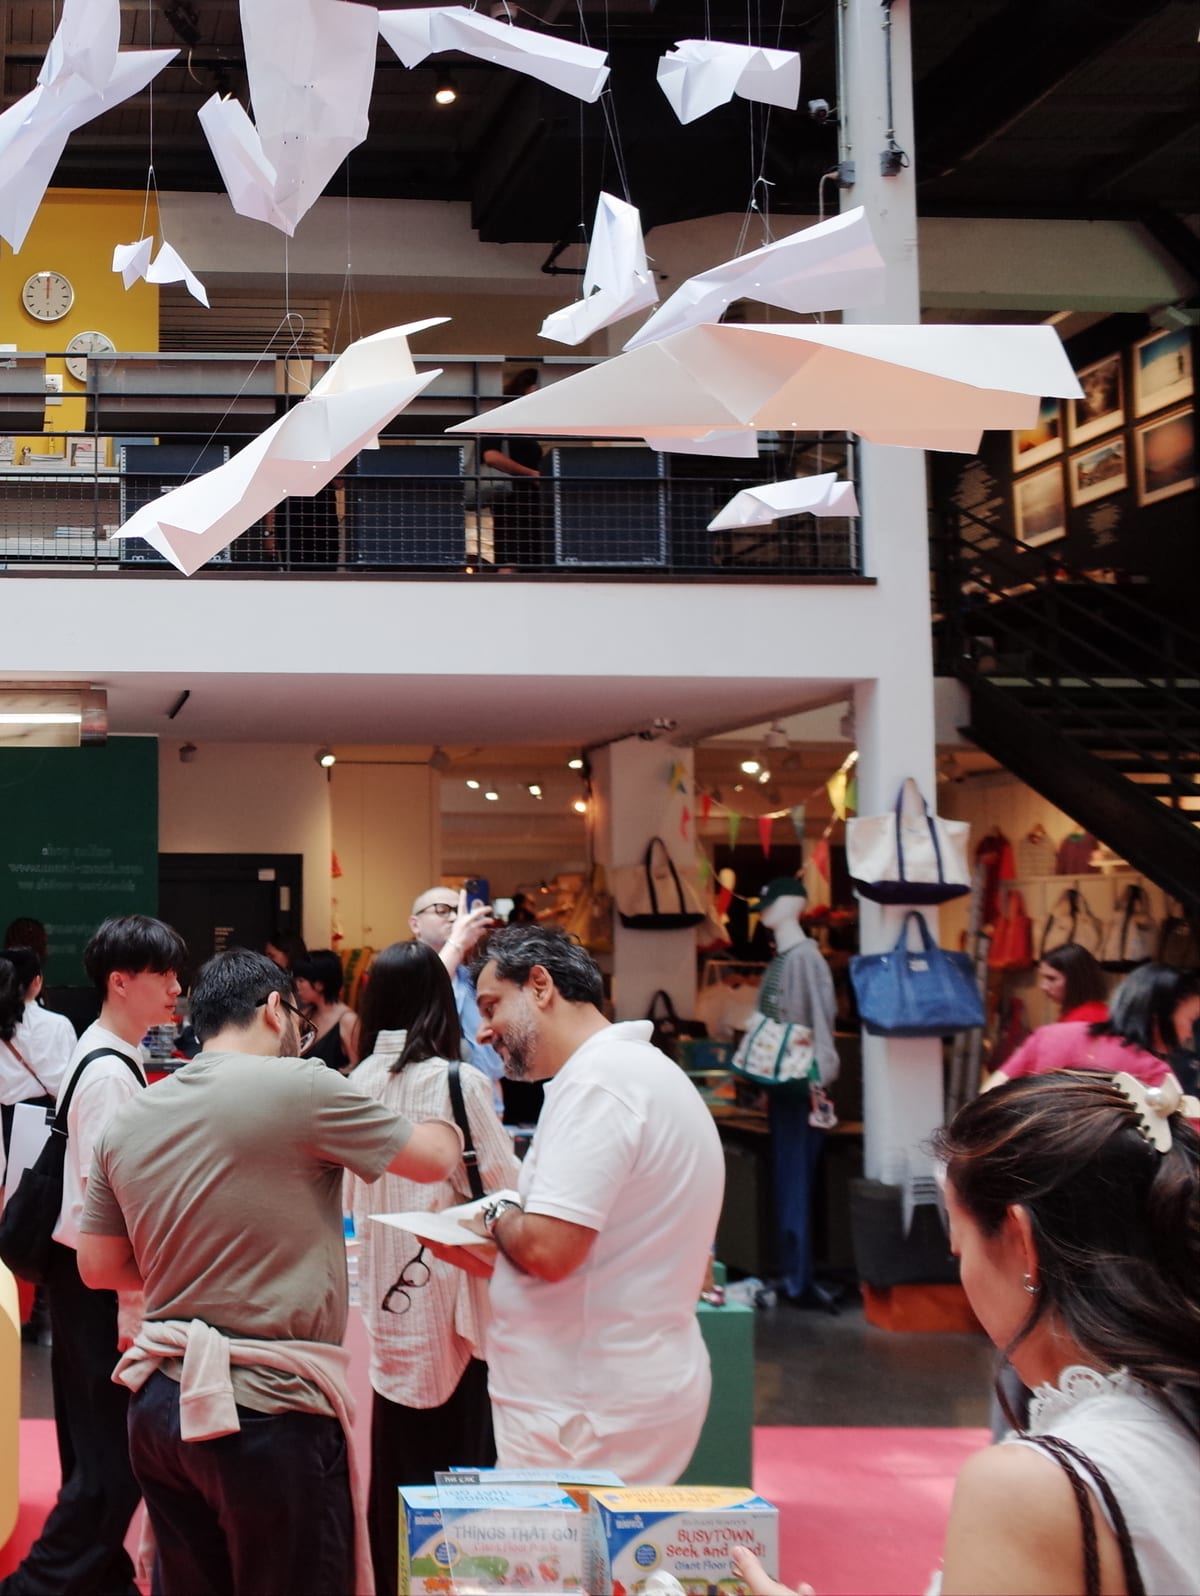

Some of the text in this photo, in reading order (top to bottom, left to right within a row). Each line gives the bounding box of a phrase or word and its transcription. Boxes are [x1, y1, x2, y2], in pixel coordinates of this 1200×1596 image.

[509, 1525, 551, 1542] THAT
[677, 1528, 756, 1543] BUSYTOWN
[666, 1544, 698, 1558] Seek
[703, 1543, 729, 1557] and
